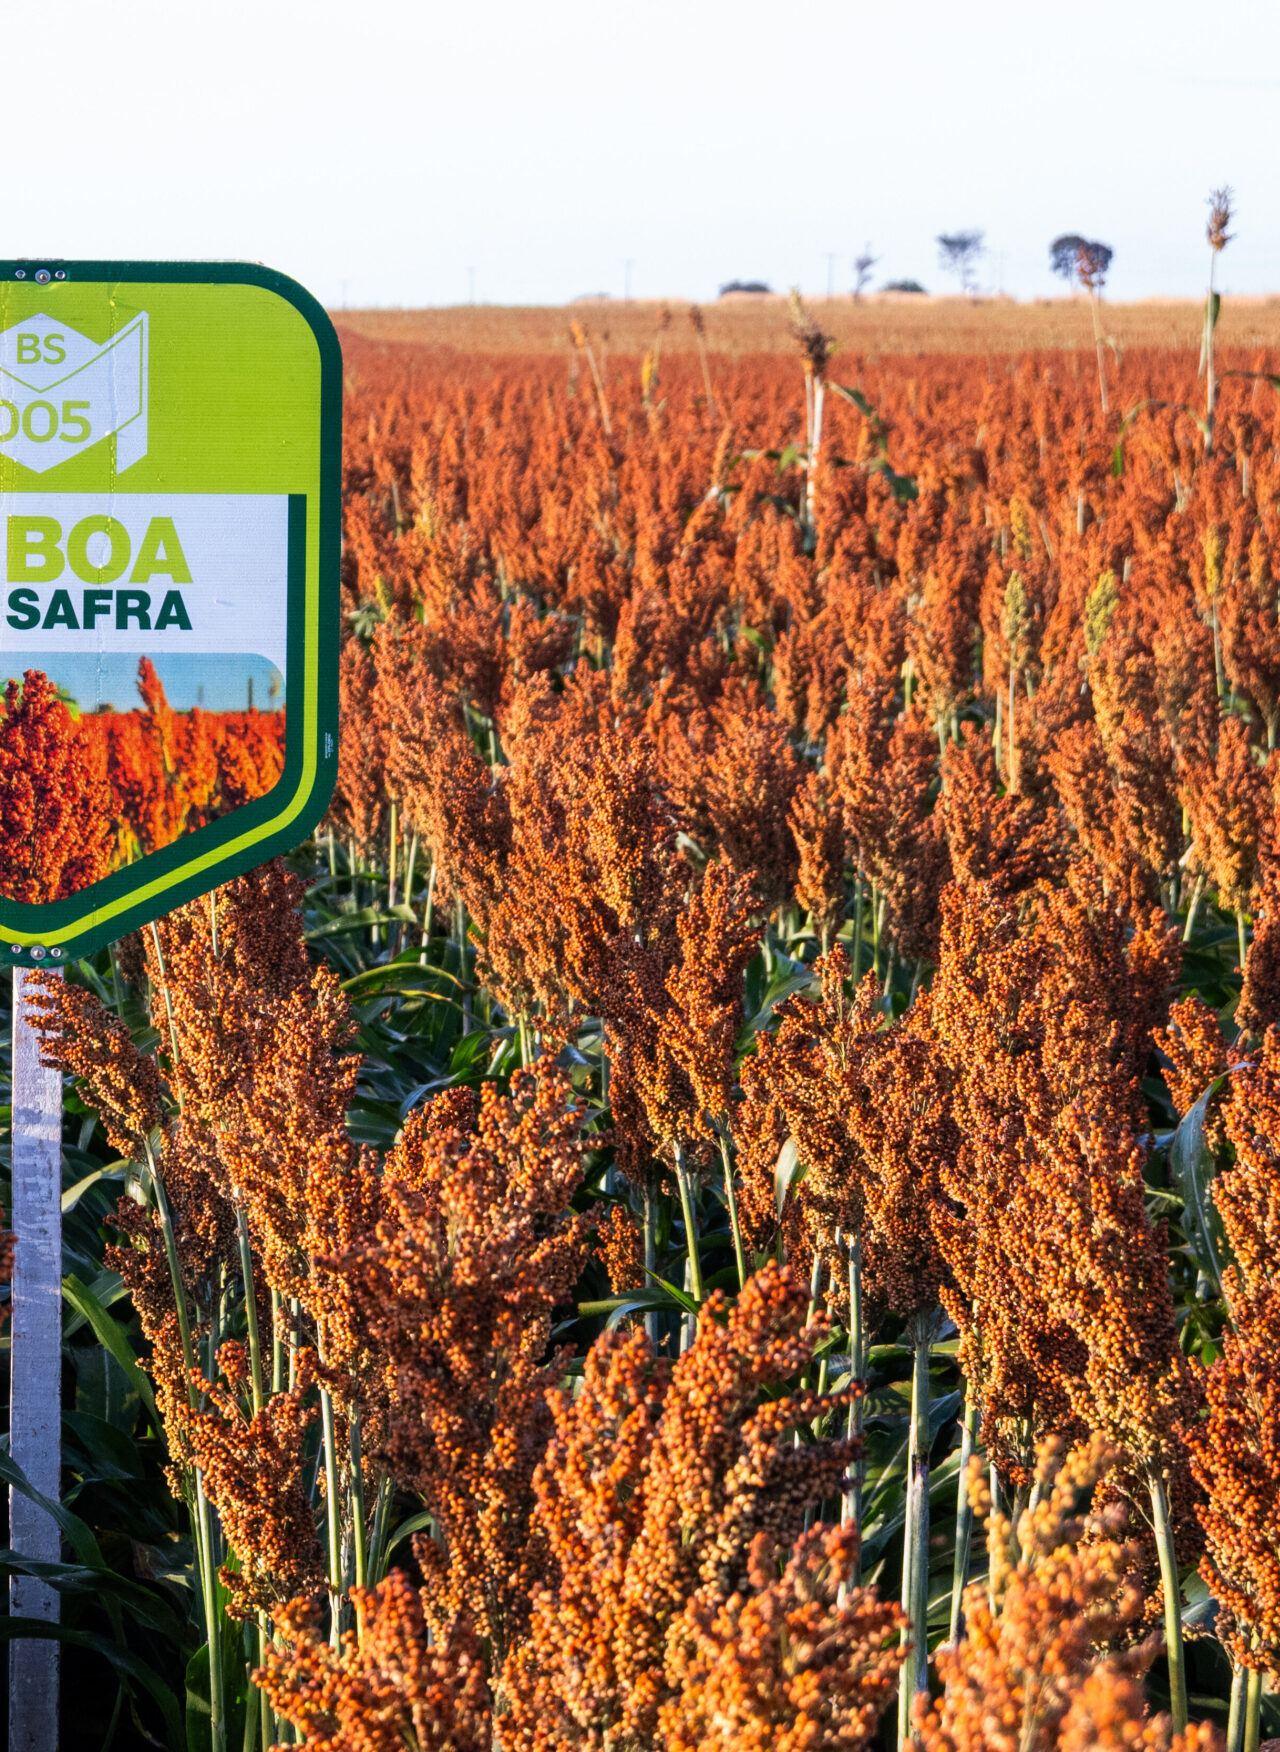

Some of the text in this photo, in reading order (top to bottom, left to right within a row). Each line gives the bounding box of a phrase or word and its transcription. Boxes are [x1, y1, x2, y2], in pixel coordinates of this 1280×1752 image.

[17, 333, 66, 364] BS
[6, 514, 193, 584] BOA
[6, 588, 193, 630] SAFRA
